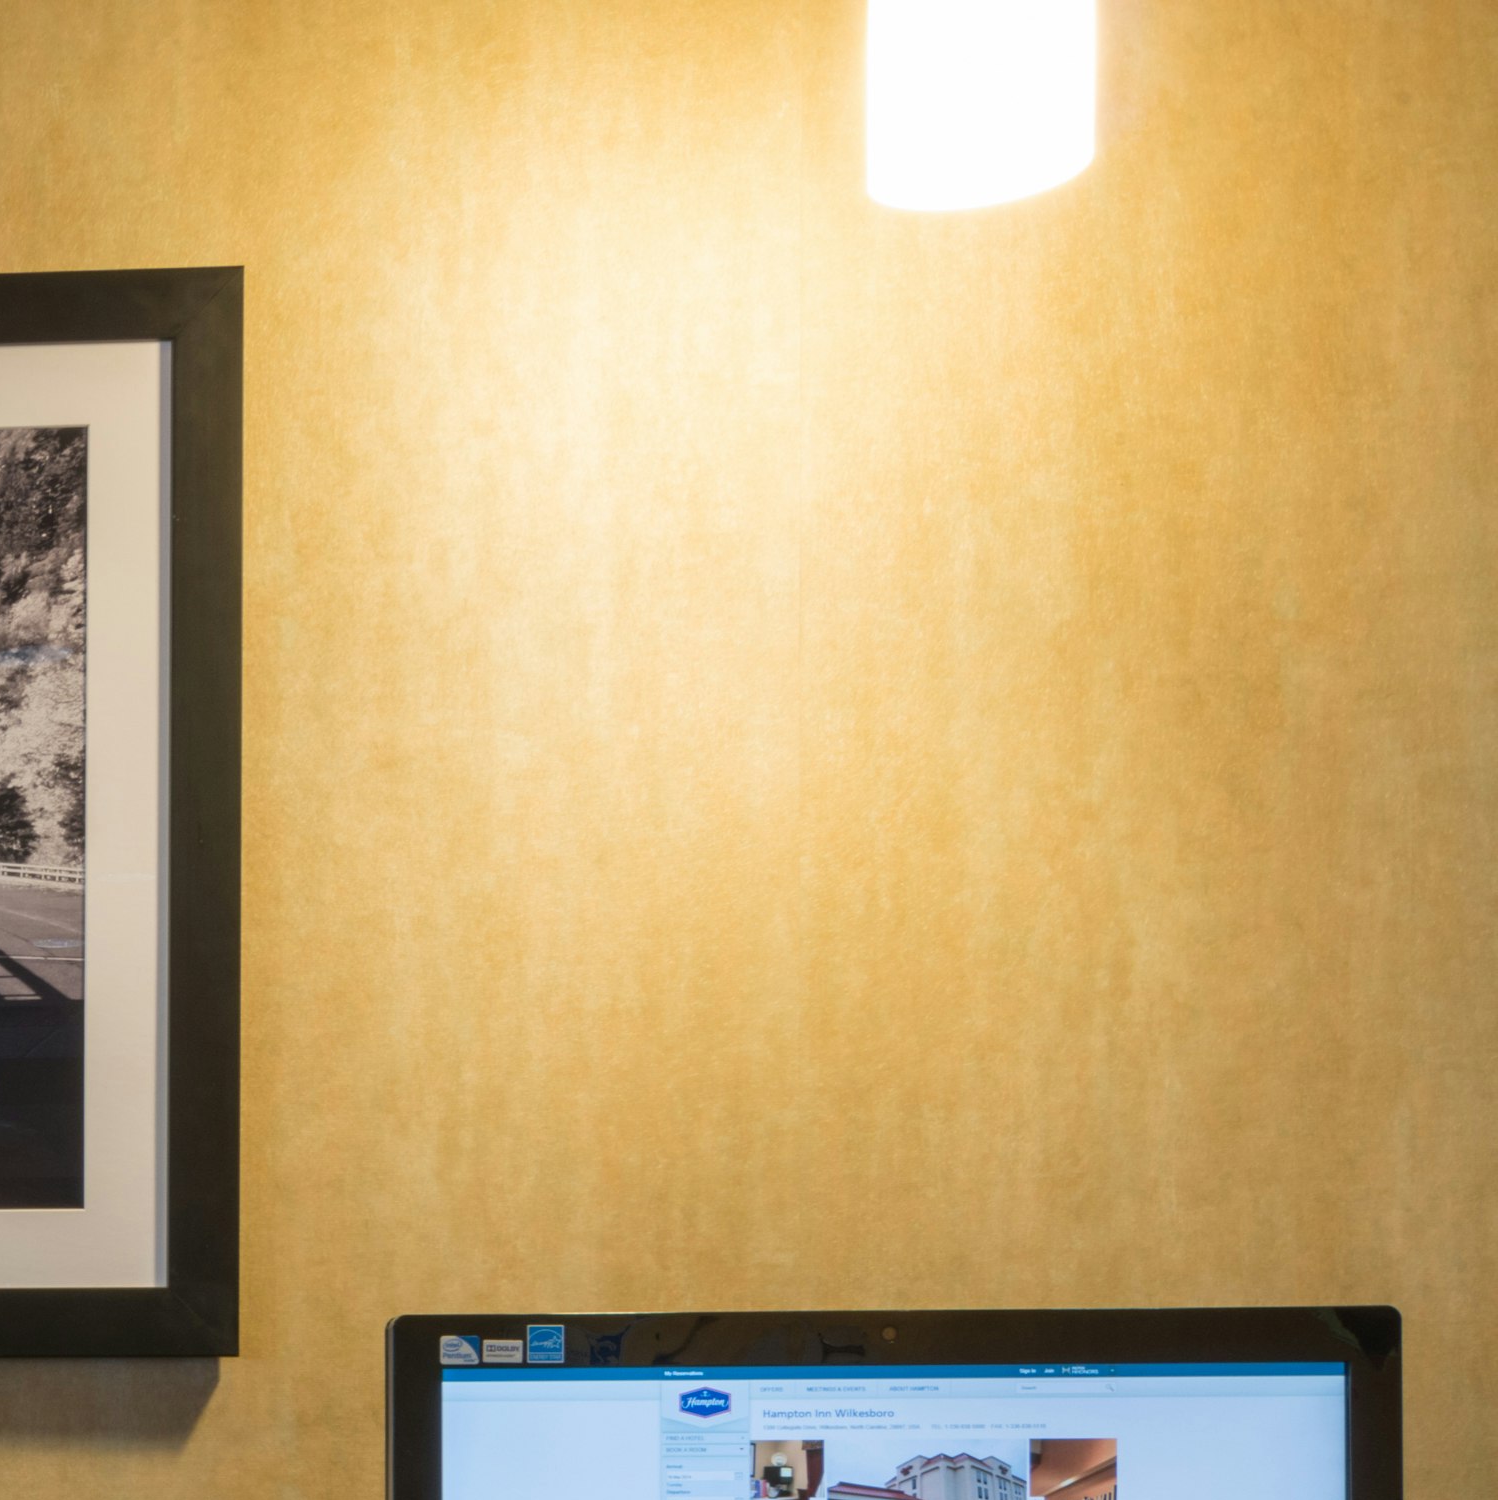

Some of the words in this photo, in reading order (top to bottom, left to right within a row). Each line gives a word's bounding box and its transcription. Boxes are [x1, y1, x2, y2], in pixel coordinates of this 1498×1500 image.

[682, 1396, 728, 1408] Hampton
[763, 1410, 811, 1419] Hampton
[815, 1409, 831, 1418] Inn
[835, 1409, 894, 1418] Wilkesboro
